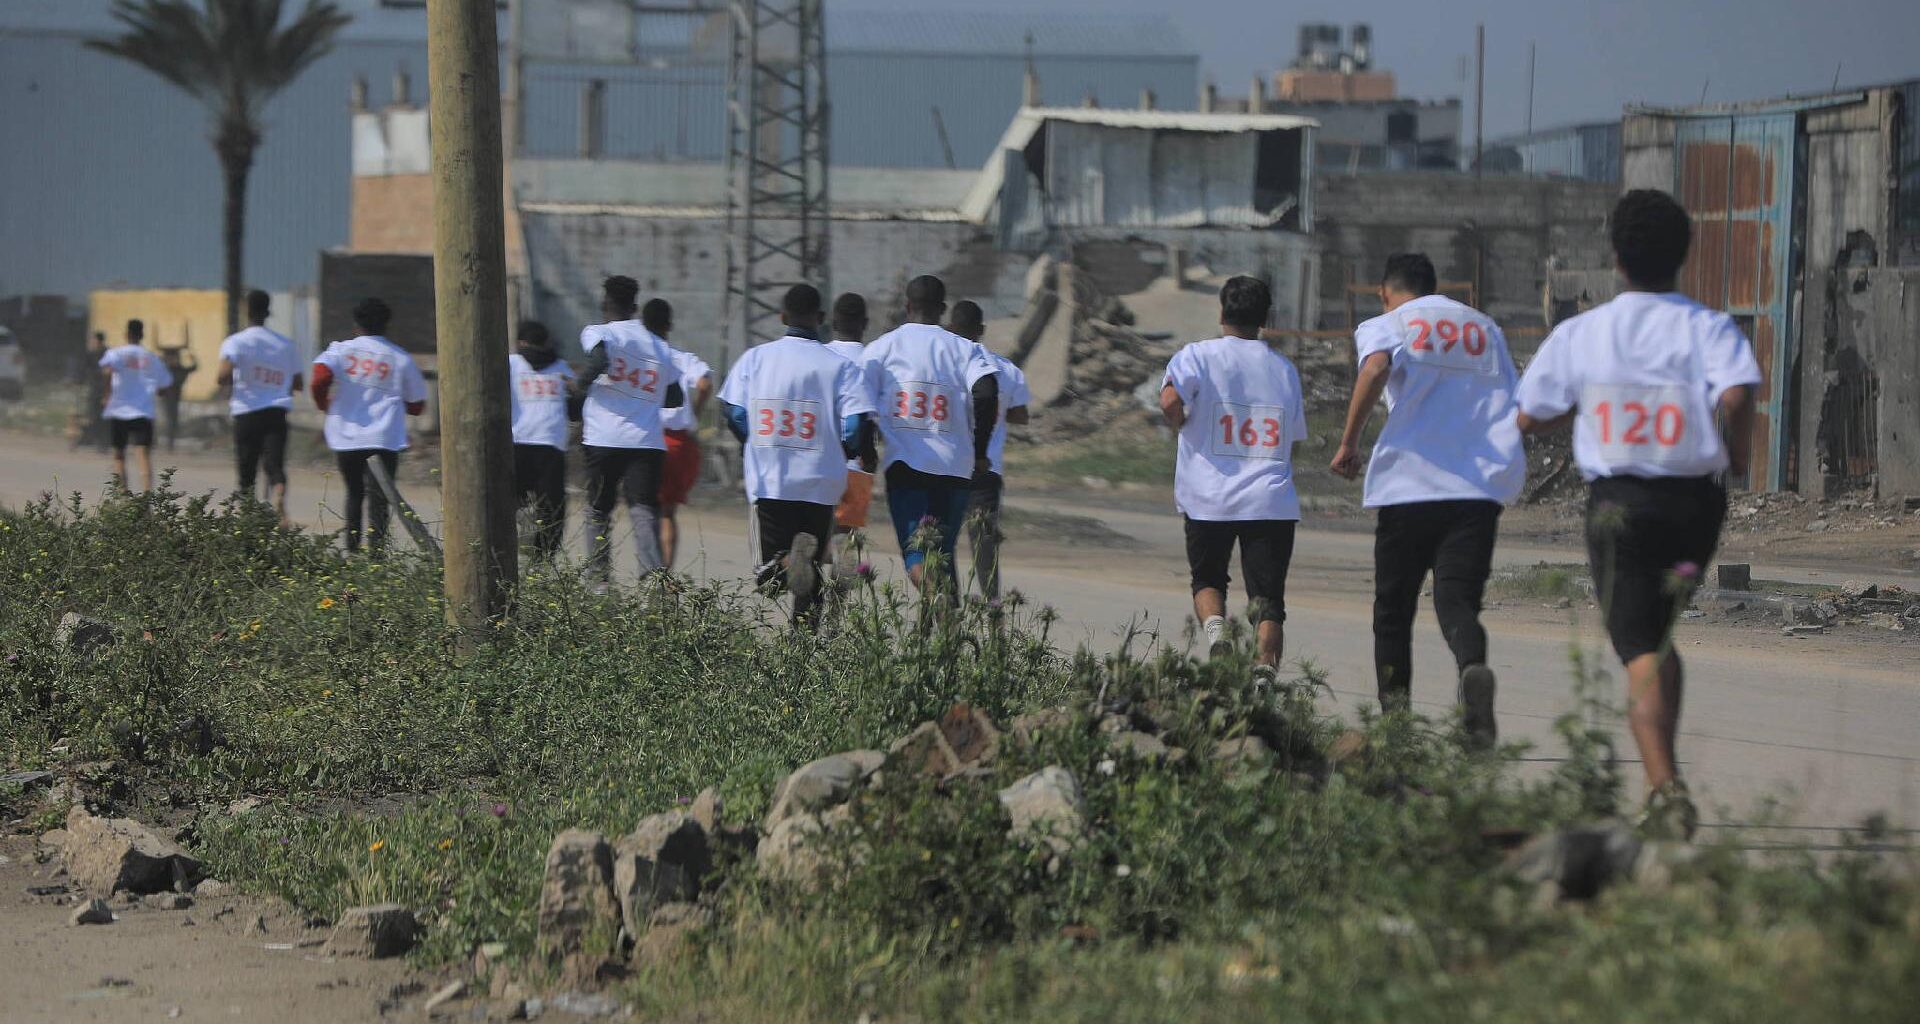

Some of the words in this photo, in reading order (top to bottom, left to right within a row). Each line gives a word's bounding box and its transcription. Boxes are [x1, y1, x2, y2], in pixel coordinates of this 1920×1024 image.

[1408, 319, 1485, 356] 290
[345, 354, 391, 381] 299
[608, 357, 658, 394] 342
[895, 391, 948, 421] 338
[757, 408, 816, 440] 333
[1220, 415, 1280, 448] 163
[1593, 401, 1685, 447] 120
